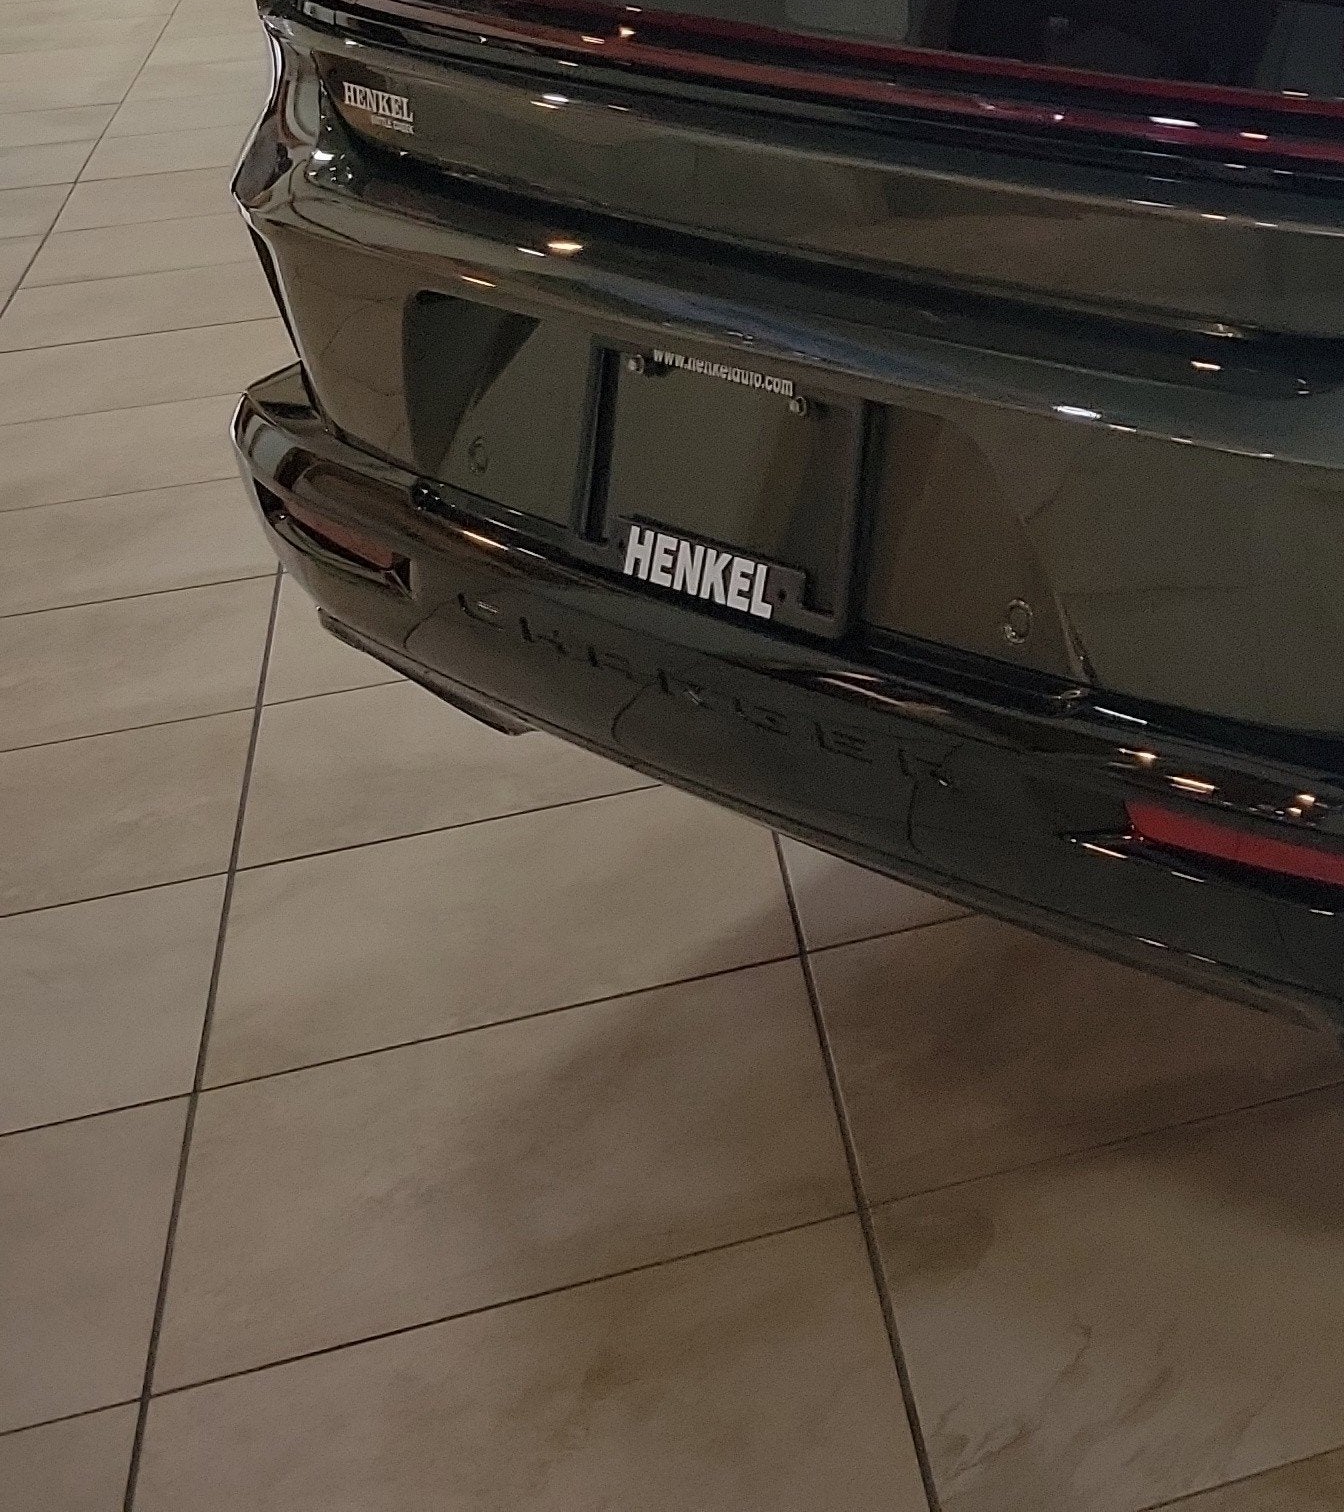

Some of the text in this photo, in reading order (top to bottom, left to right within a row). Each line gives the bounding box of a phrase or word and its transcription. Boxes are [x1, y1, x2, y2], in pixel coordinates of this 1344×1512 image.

[342, 81, 414, 122] HENKEL
[623, 524, 773, 620] HENKEL
[457, 593, 953, 788] CHARGER
